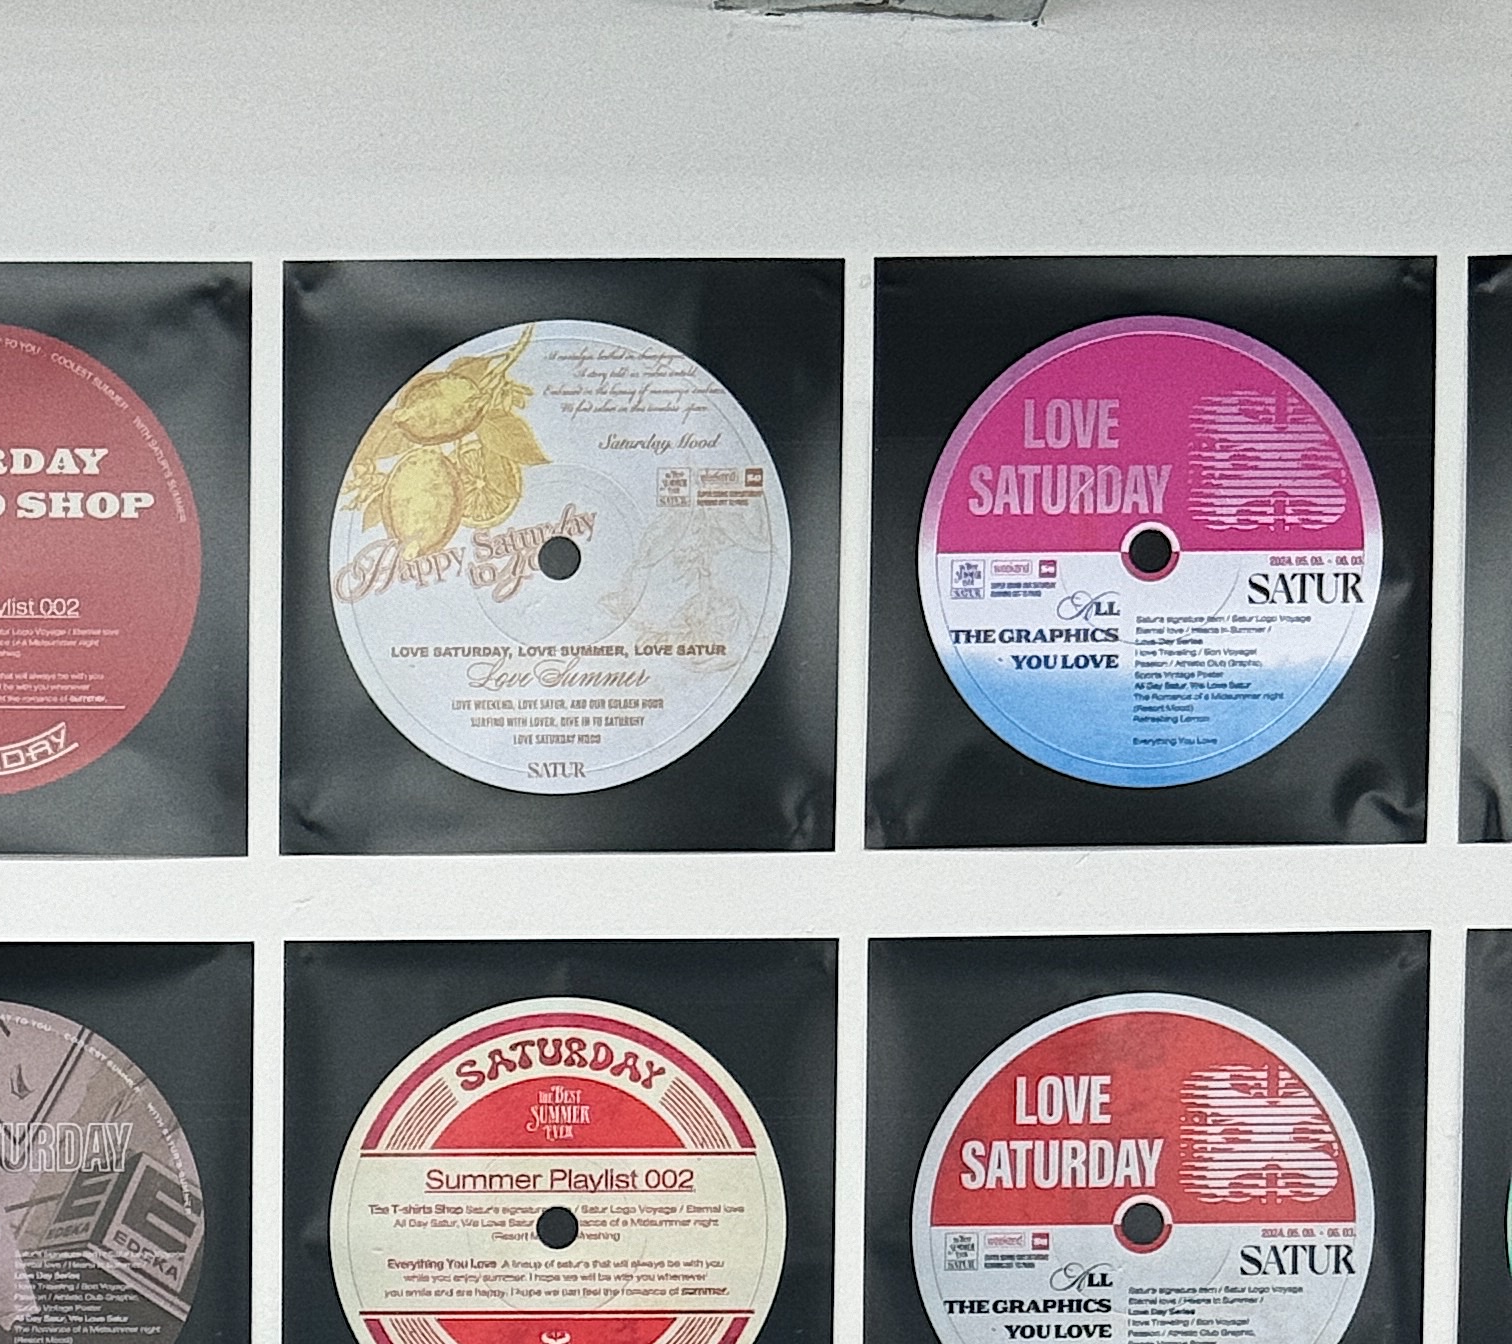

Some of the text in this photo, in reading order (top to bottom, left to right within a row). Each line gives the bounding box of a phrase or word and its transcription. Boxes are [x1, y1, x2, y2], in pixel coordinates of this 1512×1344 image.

[1023, 398, 1121, 450] LOVE
[598, 431, 723, 456] Saturday Mood
[967, 463, 1173, 516] SATURDAY
[15, 491, 155, 520] SHOP
[471, 502, 598, 562] Saturday
[333, 536, 468, 605] Happy
[1247, 572, 1365, 605] SATUR
[39, 596, 80, 615] 002
[950, 627, 1120, 645] THE GRAPHICS
[391, 646, 429, 658] LOVE
[432, 646, 514, 660] SATURDAY,
[517, 645, 557, 658] LOVE
[634, 644, 673, 657] LOVE
[675, 644, 727, 656] SATUR
[1011, 653, 1120, 670] YOU LOVE
[466, 656, 651, 692] Love Summer
[526, 761, 586, 779] SATUR
[454, 1036, 667, 1092] SATURDAY
[1014, 1074, 1111, 1126] LOVE
[525, 1104, 591, 1132] SUMMER
[960, 1138, 1165, 1190] SATURDAY
[425, 1167, 695, 1193] Summer Playlist 002
[112, 1229, 179, 1281] EDEKA
[387, 1258, 444, 1271] Everything
[445, 1258, 468, 1269] You
[1239, 1243, 1357, 1276] SATUR
[943, 1298, 1113, 1315] THE GRAPHICS
[1004, 1323, 1113, 1340] YOU LOVE
